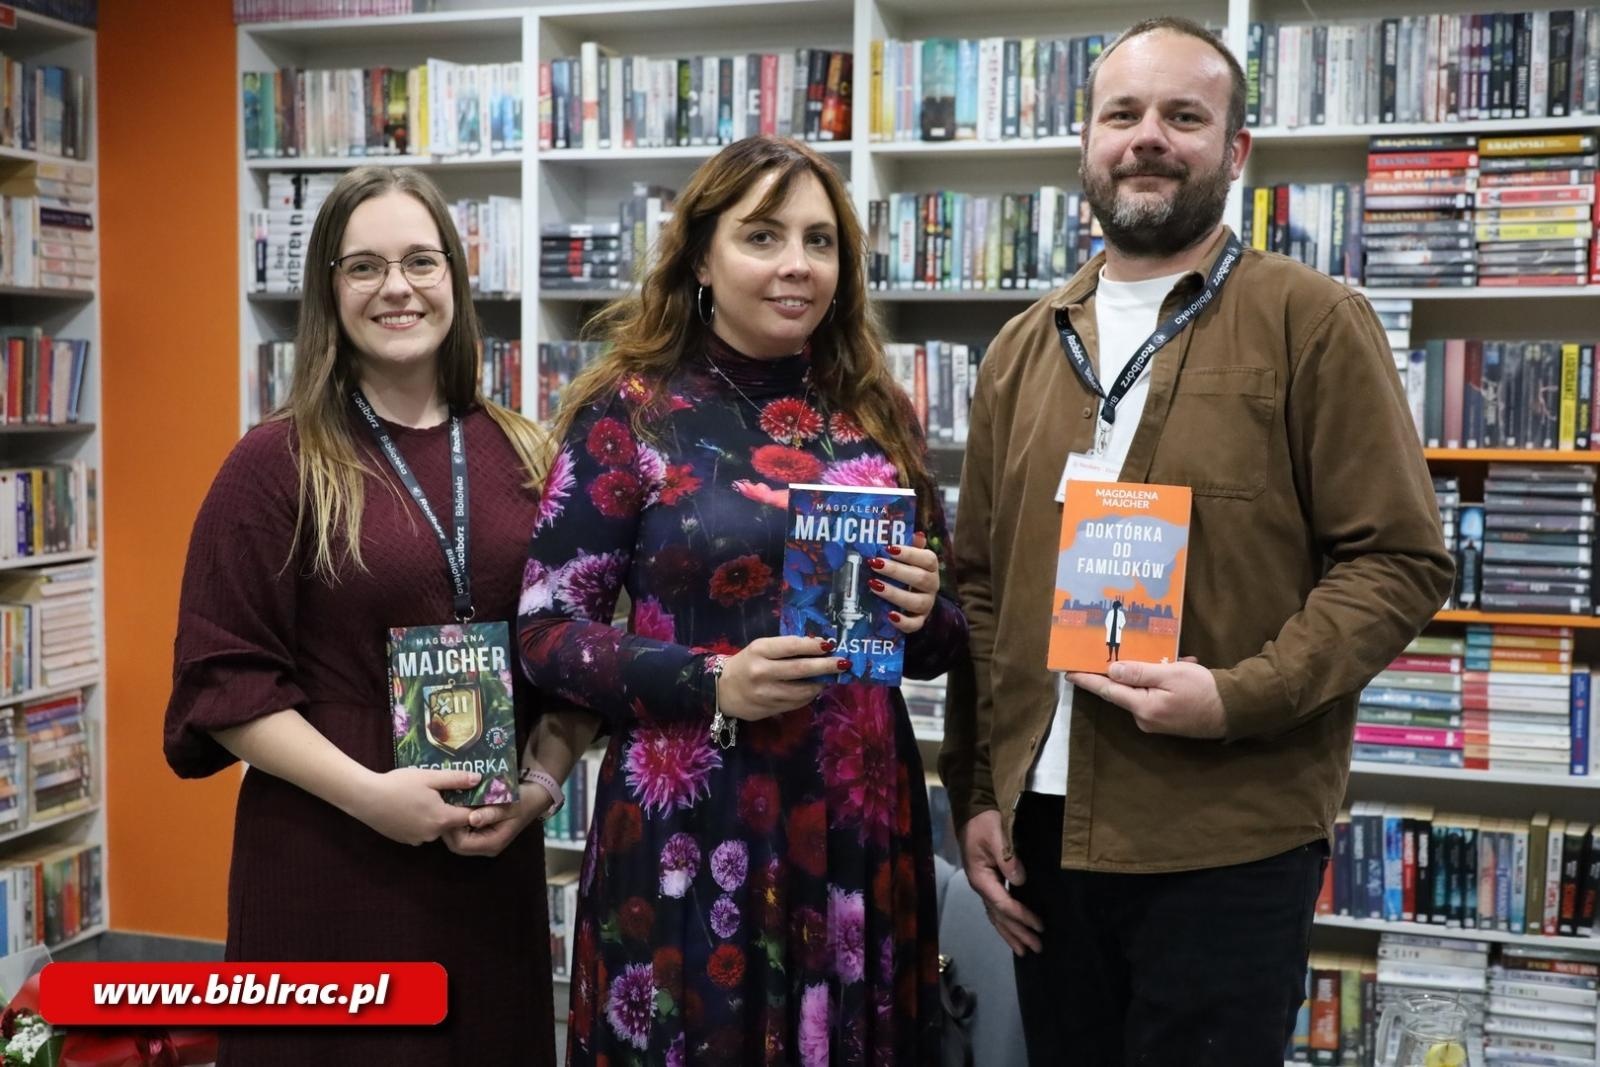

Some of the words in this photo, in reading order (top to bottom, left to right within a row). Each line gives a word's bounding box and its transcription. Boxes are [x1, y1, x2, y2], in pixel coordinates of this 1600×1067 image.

[1393, 169, 1451, 180] ERYNIE
[1212, 253, 1236, 287] Racibórz
[1174, 289, 1215, 325] Biblioteka
[1121, 343, 1157, 389] Racibórz
[352, 391, 379, 429] Racibórz
[380, 434, 408, 475] Biblioteka
[455, 475, 465, 518] Biblioteka
[1095, 488, 1159, 500] MAGDALENA
[1102, 498, 1150, 509] MAJCHER
[816, 503, 888, 514] MAGDALENA
[794, 514, 906, 545] MAJCHER
[1085, 521, 1163, 543] DOKTÓRKA
[419, 497, 446, 540] Racibórz
[446, 548, 464, 594] Biblioteka
[1112, 541, 1132, 557] OD
[1077, 557, 1165, 579] FAMILOKÓW
[416, 634, 485, 645] MAGDALENA
[827, 637, 894, 656] CASTER
[398, 646, 507, 678] MAJCHER
